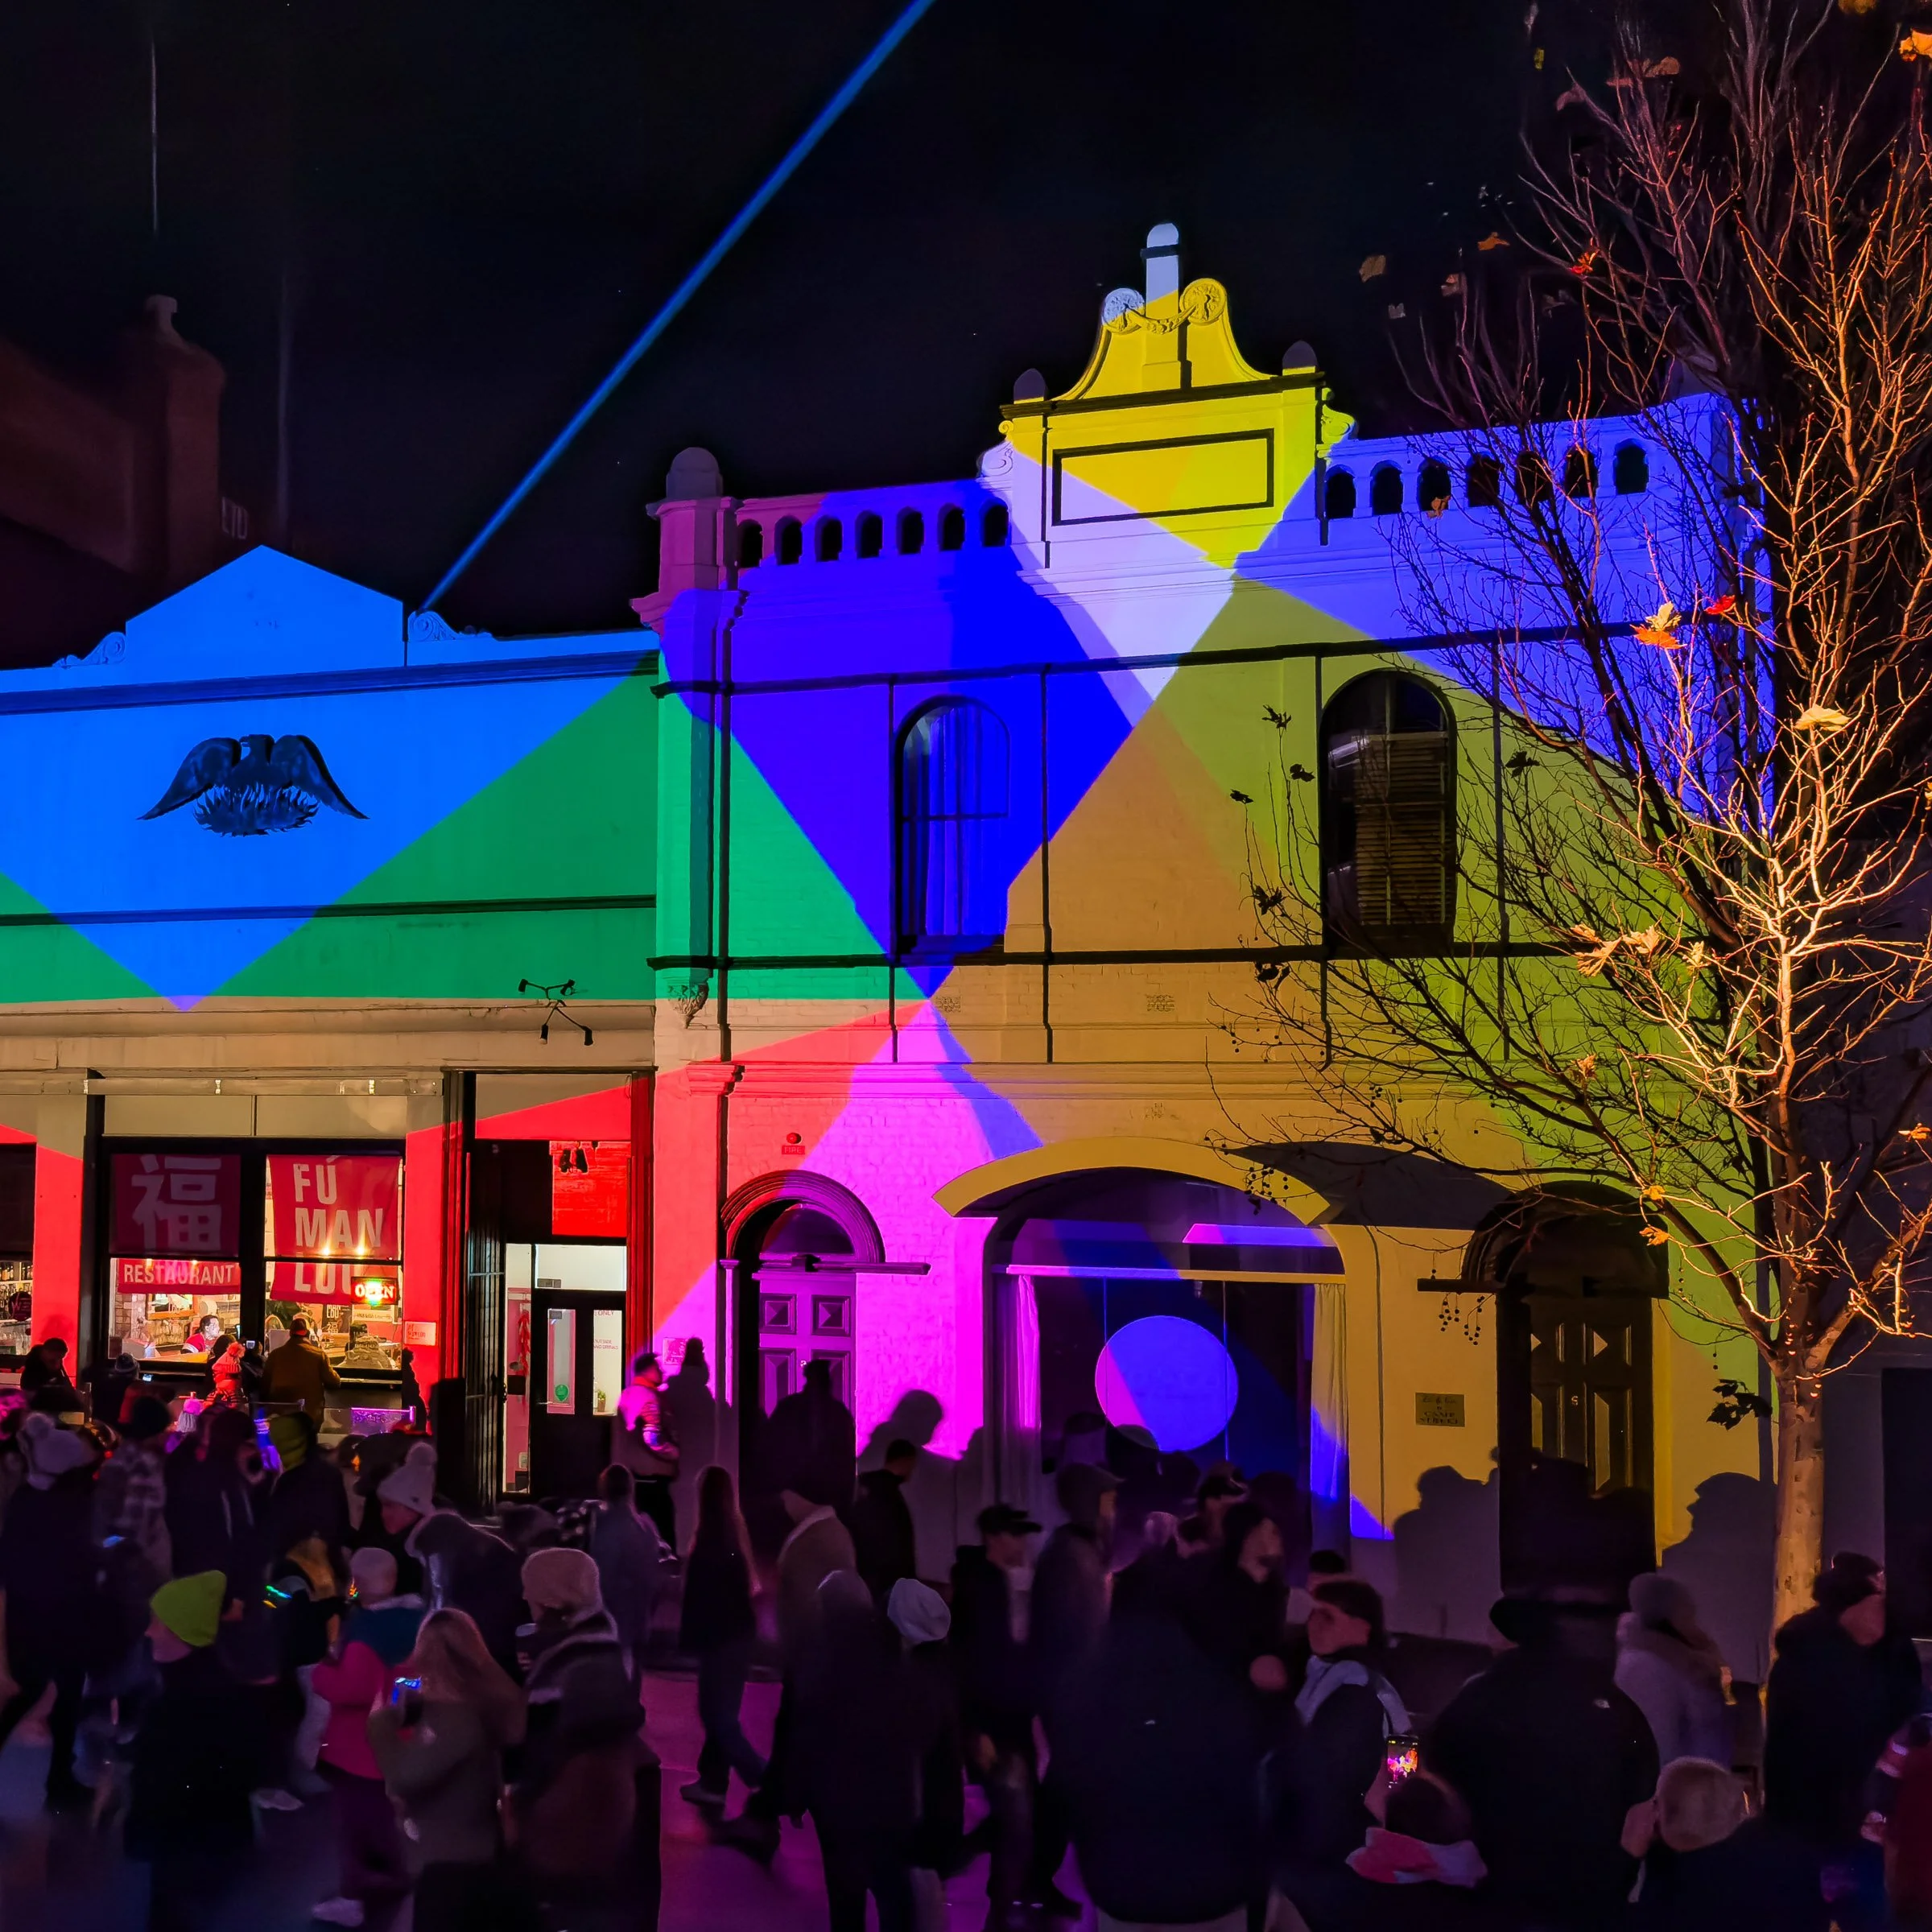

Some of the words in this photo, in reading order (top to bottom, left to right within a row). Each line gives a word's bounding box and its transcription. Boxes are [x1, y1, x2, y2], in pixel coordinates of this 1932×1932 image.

[131, 1154, 221, 1251] 福
[295, 1208, 383, 1248] MAN
[124, 1264, 234, 1285] RESTAURANT
